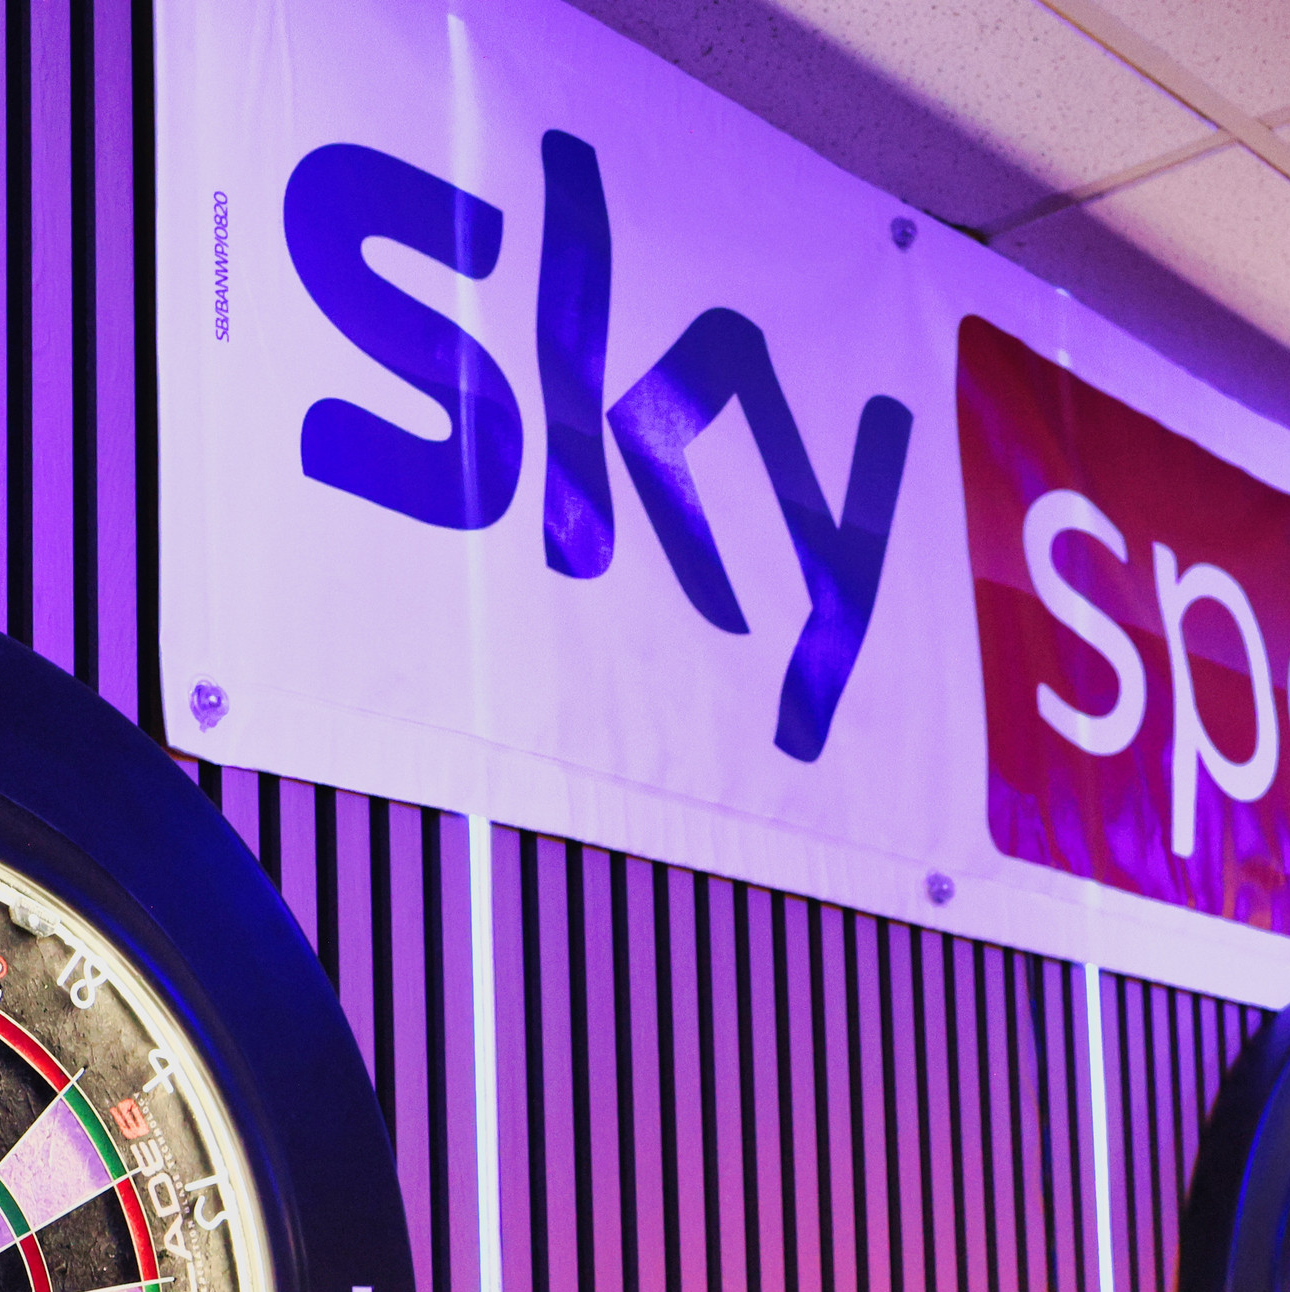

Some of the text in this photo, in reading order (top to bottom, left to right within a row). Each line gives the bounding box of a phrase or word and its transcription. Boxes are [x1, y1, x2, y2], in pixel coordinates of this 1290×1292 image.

[213, 191, 230, 343] SB/BANWP/0820
[283, 128, 913, 763] sky
[56, 950, 111, 1011] 18
